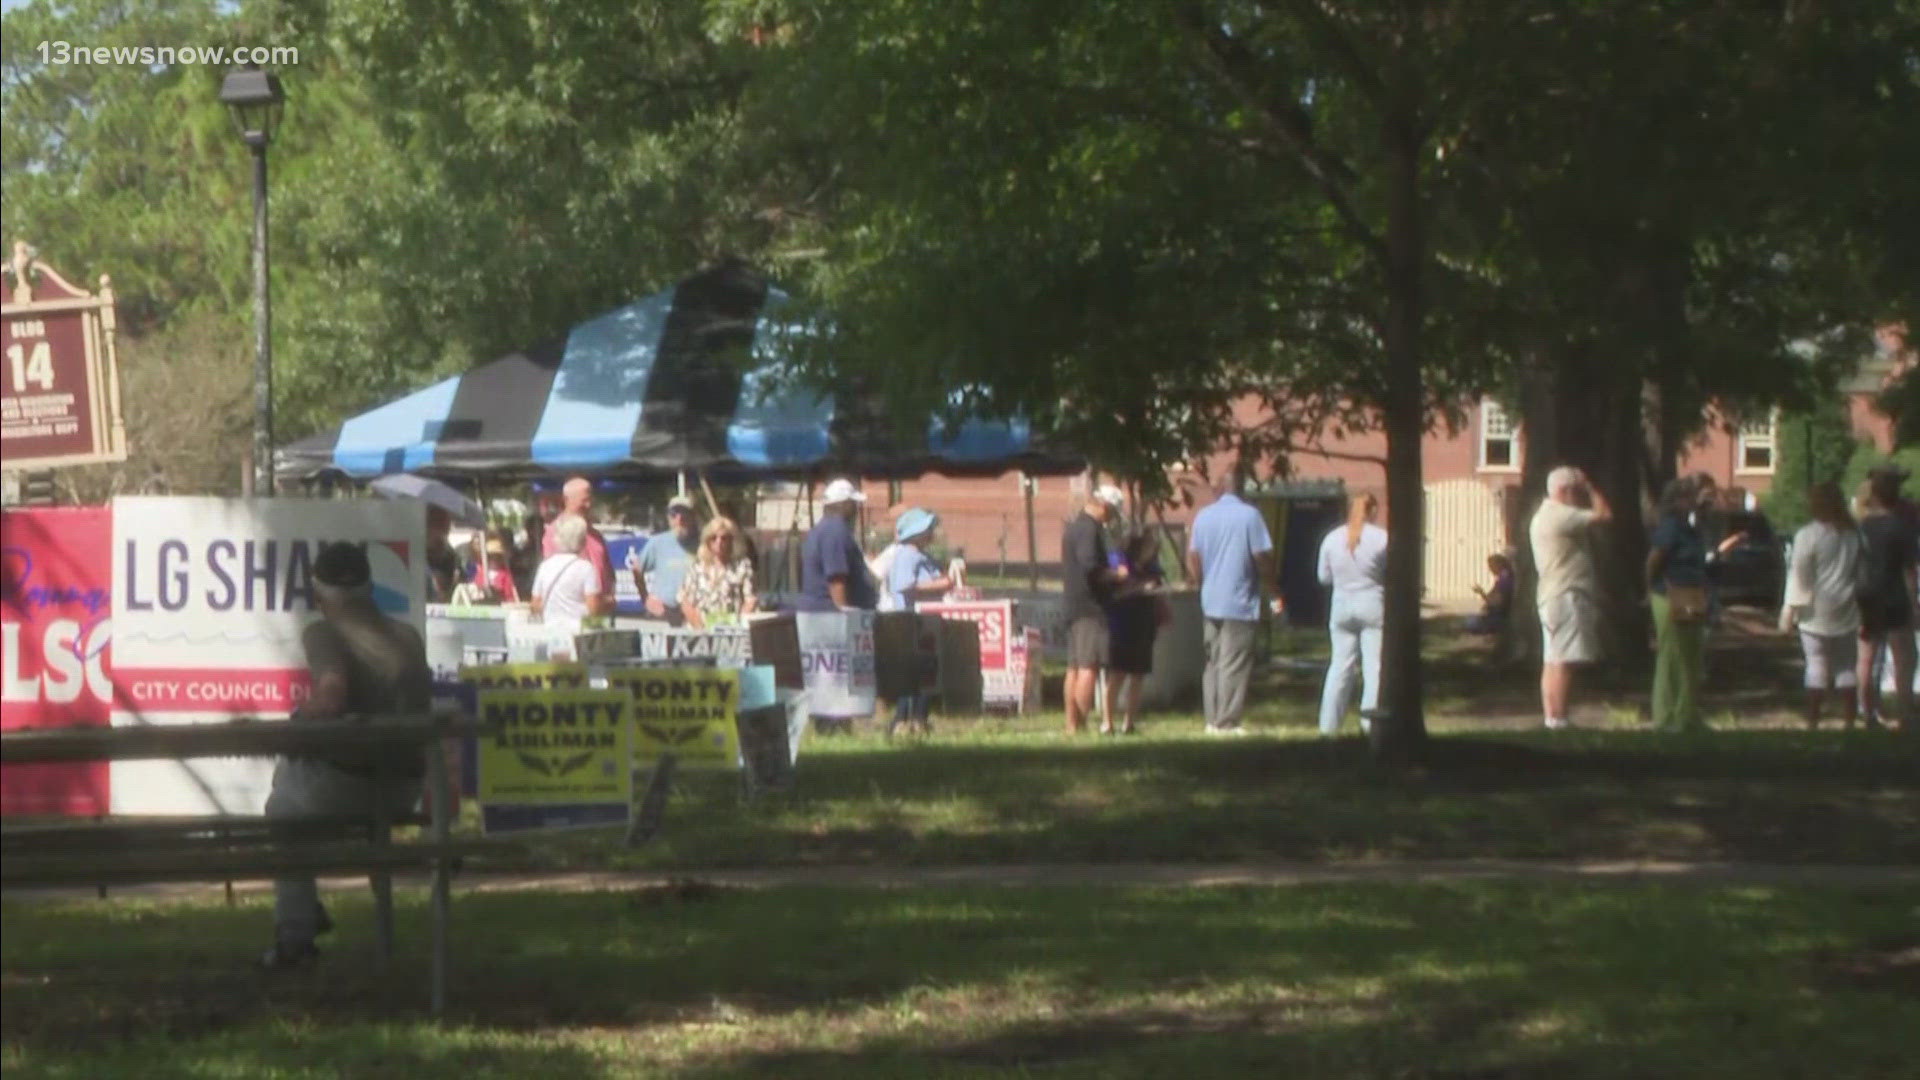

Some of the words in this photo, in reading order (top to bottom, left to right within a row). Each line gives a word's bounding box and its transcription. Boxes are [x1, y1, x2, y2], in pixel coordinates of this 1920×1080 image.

[6, 342, 55, 392] 14
[126, 540, 189, 611] LG
[206, 540, 367, 612] SHA
[672, 634, 752, 658] KAINE
[132, 682, 180, 698] CITY
[186, 682, 283, 700] COUNCIL
[484, 703, 624, 726] MONTY
[634, 705, 726, 720] SHLIMAN
[495, 731, 616, 749] ASHLIMAN
